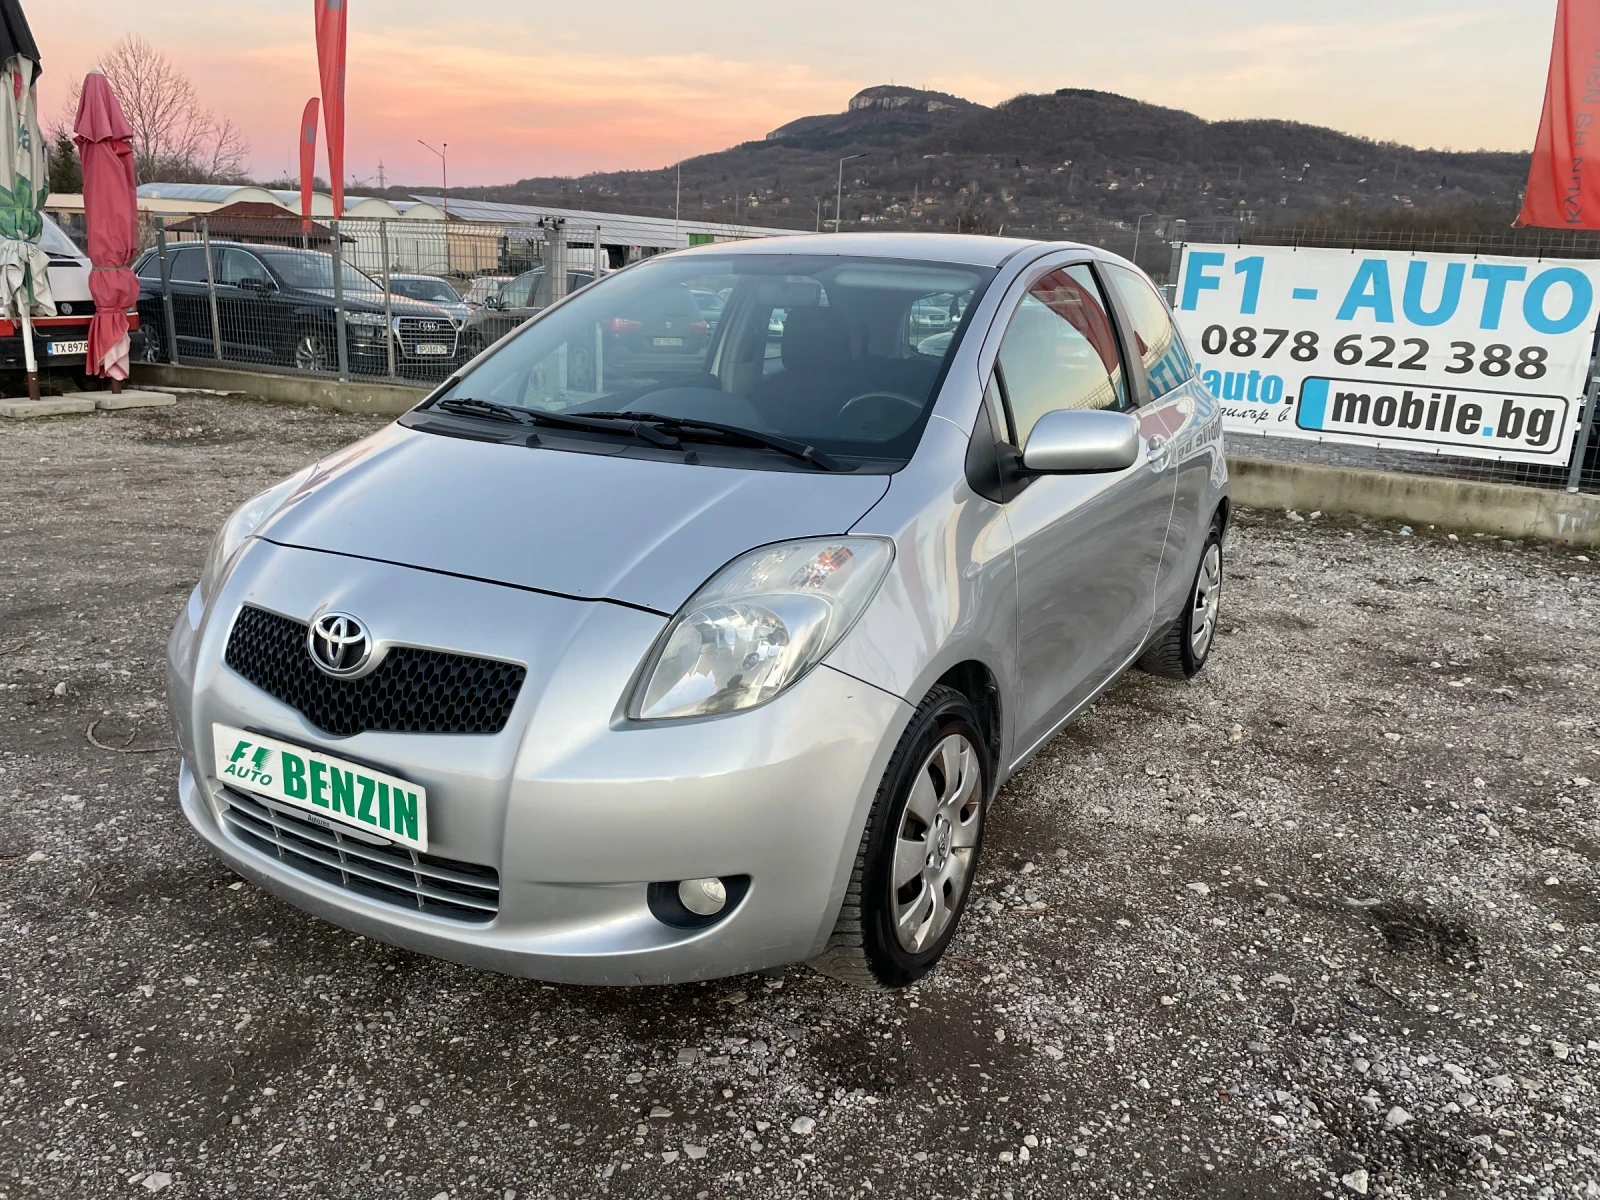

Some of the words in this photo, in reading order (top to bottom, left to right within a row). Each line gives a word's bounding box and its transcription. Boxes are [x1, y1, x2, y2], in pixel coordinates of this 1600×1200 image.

[1181, 251, 1265, 314] F1
[1335, 258, 1593, 335] AUTO
[1200, 324, 1320, 362] 0878
[1333, 333, 1430, 371] 622
[1444, 341, 1549, 380] 388
[1331, 390, 1556, 446] mobile.bg
[224, 763, 273, 787] AUTO
[230, 740, 275, 772] F1
[281, 750, 419, 842] BENZIN
